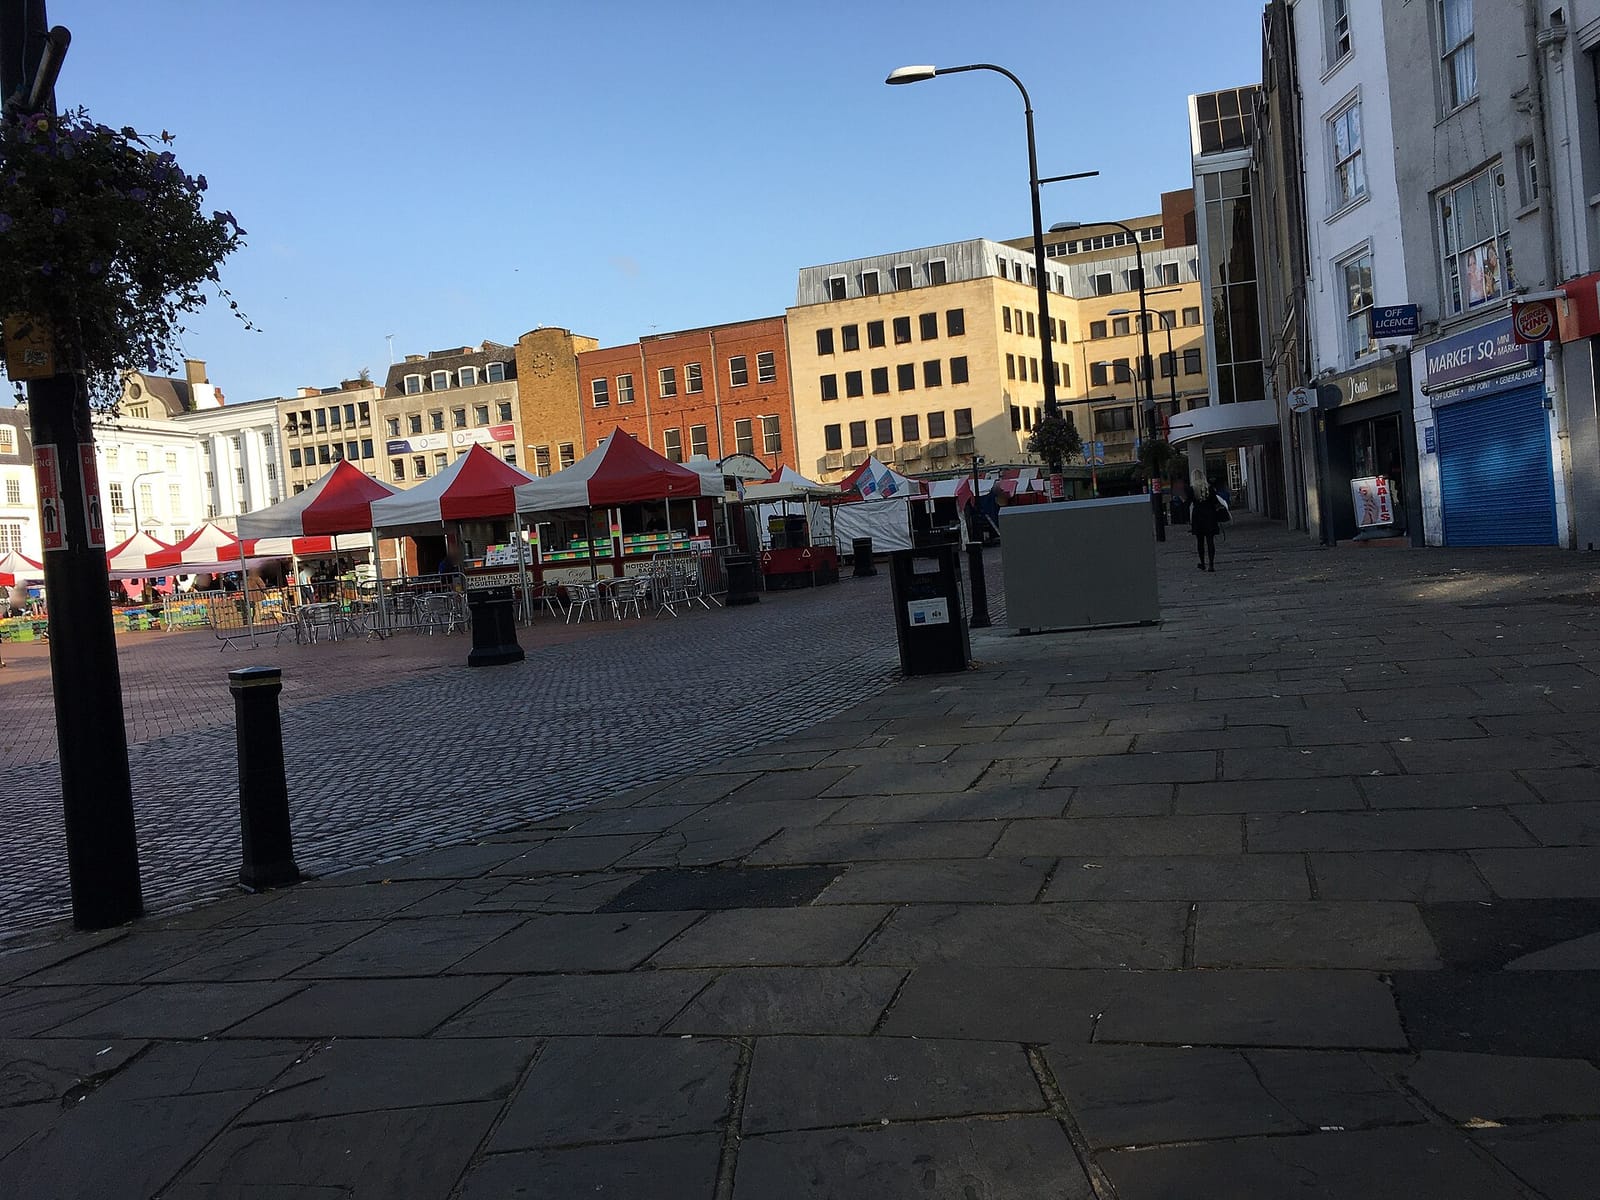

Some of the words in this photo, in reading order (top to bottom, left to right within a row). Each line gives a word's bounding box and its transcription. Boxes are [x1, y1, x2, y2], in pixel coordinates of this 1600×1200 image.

[1385, 308, 1403, 317] OFF
[1520, 307, 1546, 322] BURGER
[1376, 317, 1414, 329] LICENCE
[1522, 314, 1548, 333] KING
[1497, 333, 1510, 346] MINI
[1429, 345, 1474, 376] MARKET
[1478, 339, 1497, 362] SQ.
[1497, 344, 1523, 356] MARKET
[1443, 389, 1460, 400] LICENCE
[1477, 381, 1491, 392] POINT
[1500, 373, 1521, 385] GENERAL
[1522, 368, 1538, 379] STORE
[1376, 478, 1390, 521] NAILS
